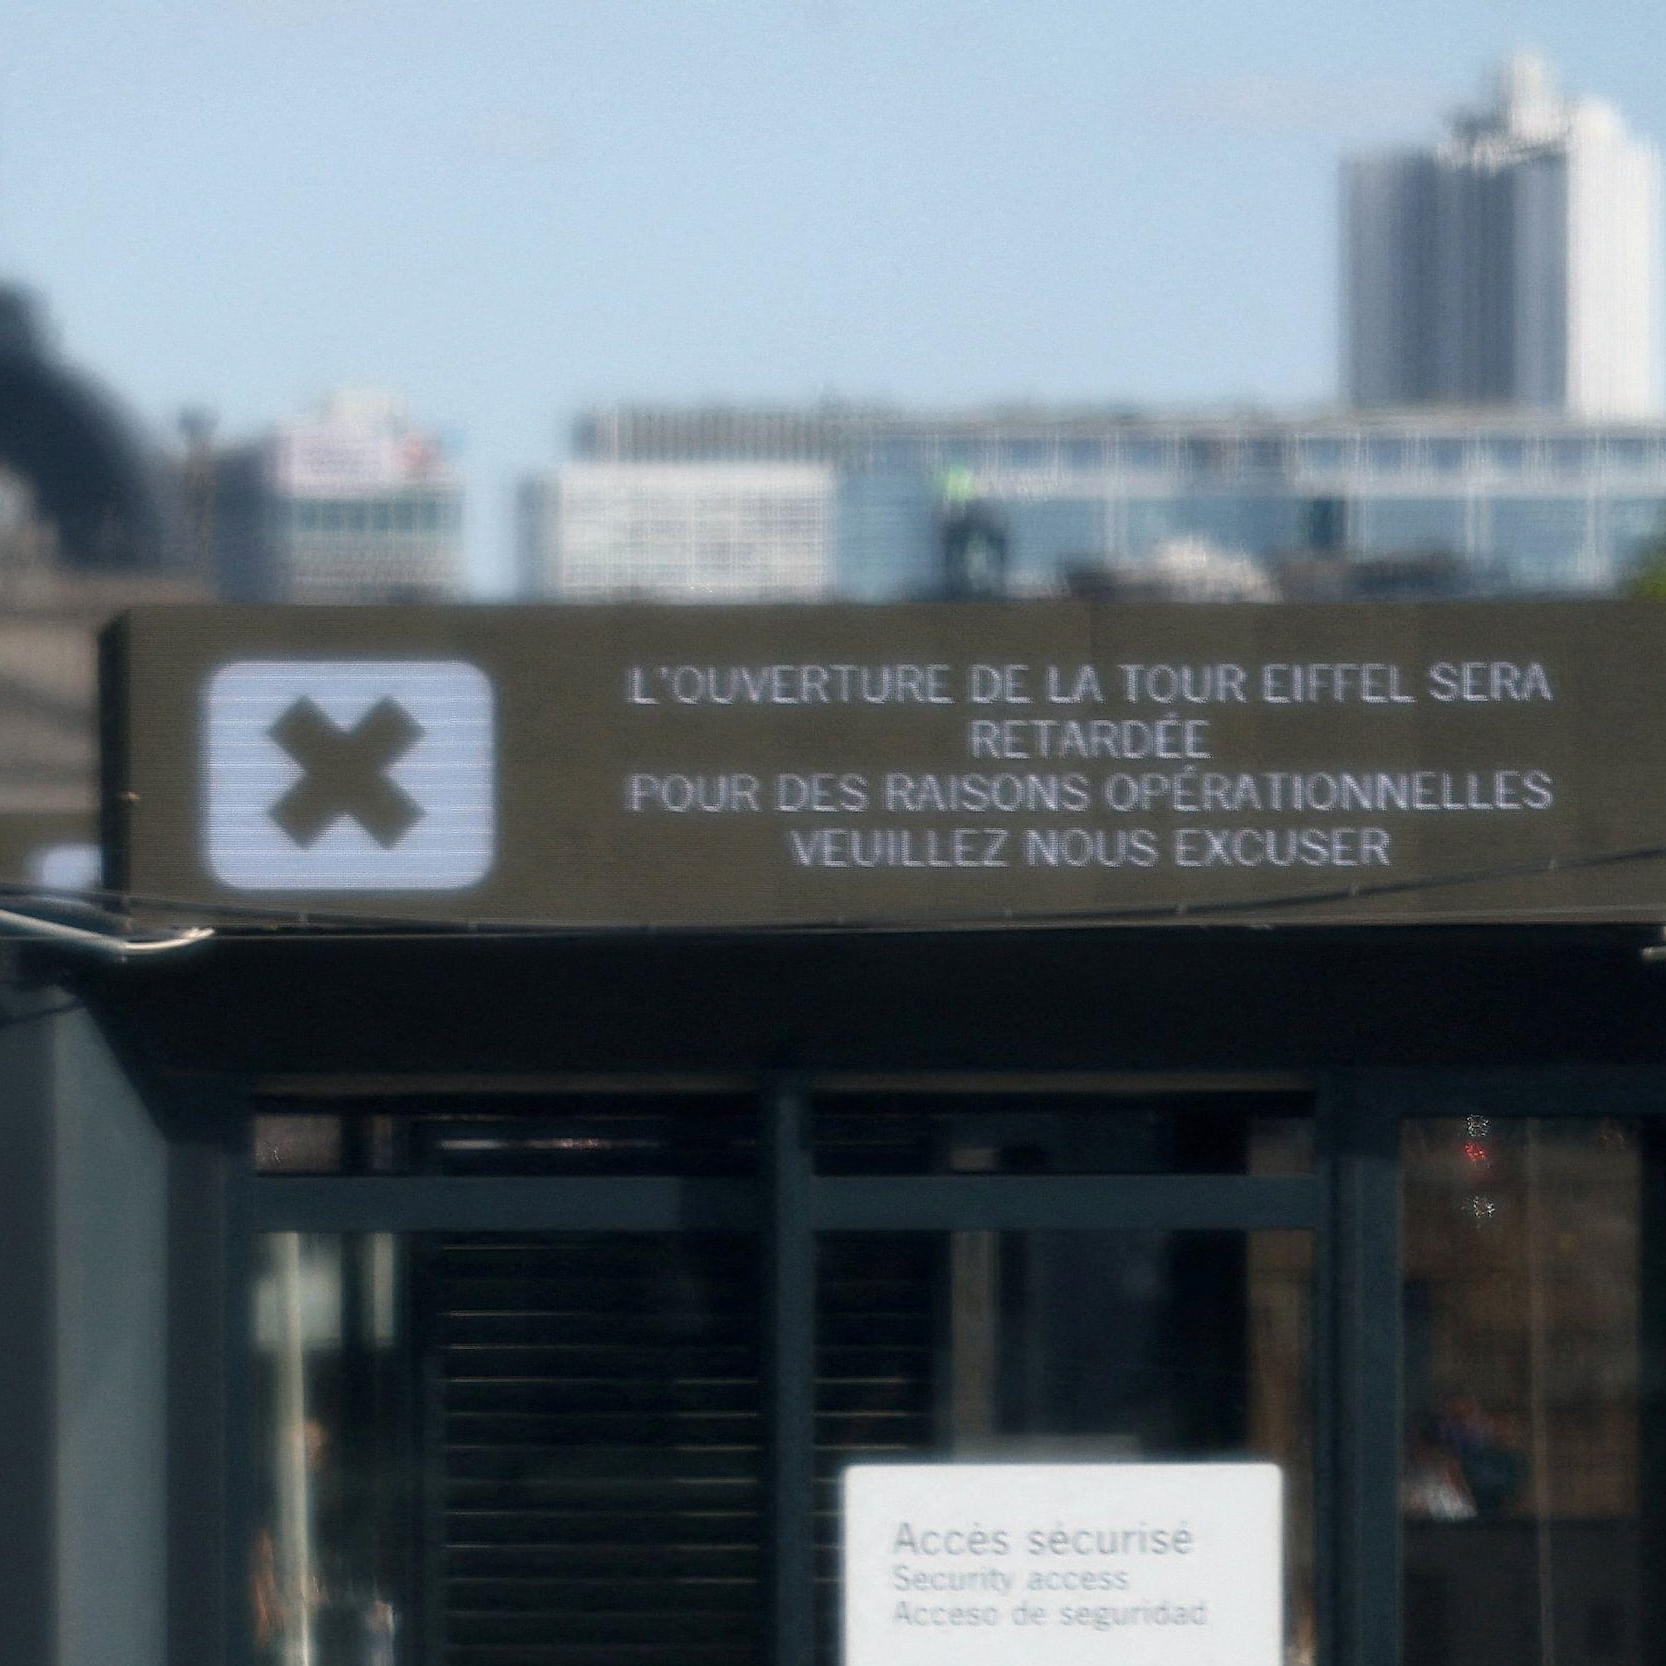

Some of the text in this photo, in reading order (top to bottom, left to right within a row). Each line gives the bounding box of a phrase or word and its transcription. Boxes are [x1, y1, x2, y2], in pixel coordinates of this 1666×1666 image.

[627, 661, 1553, 704] L'OUVERTURE DE LA TOUR EIFFEL SERA
[968, 712, 1212, 759] RETARDÉE
[627, 765, 1554, 813] POUR DES RAISONS OPÉRATIONNELLES
[789, 828, 1391, 868] VEUILLEZ NOUS EXCUSER
[894, 1520, 1193, 1556] Accès sécurisé
[893, 1565, 1129, 1595] Security access
[894, 1600, 1207, 1632] Acceso de seguridad
